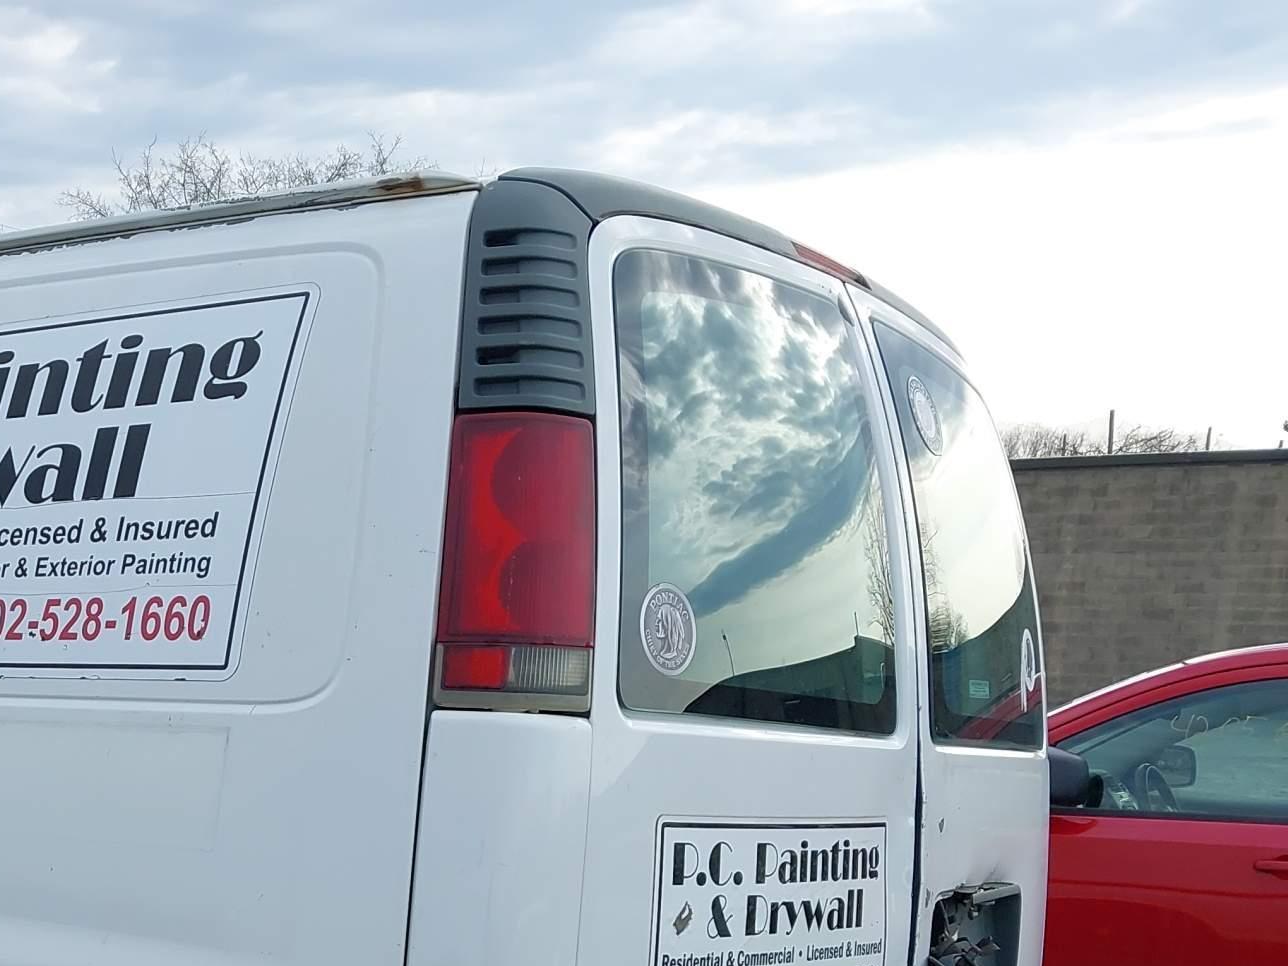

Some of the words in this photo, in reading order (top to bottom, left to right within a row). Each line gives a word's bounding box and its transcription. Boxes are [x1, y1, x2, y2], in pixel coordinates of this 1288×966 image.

[90, 517, 107, 542] &
[116, 512, 219, 541] Insured
[15, 558, 27, 578] &
[35, 555, 116, 577] Exterior
[121, 552, 211, 578] Painting
[650, 592, 689, 620] PONTIAC
[672, 842, 743, 886] P.C.
[756, 840, 879, 884] Painting
[707, 895, 733, 939] &
[745, 889, 863, 936] Drywall
[737, 946, 794, 966] Commercial
[807, 942, 844, 961] Licensed
[846, 942, 852, 957] &
[854, 938, 882, 956] Insured
